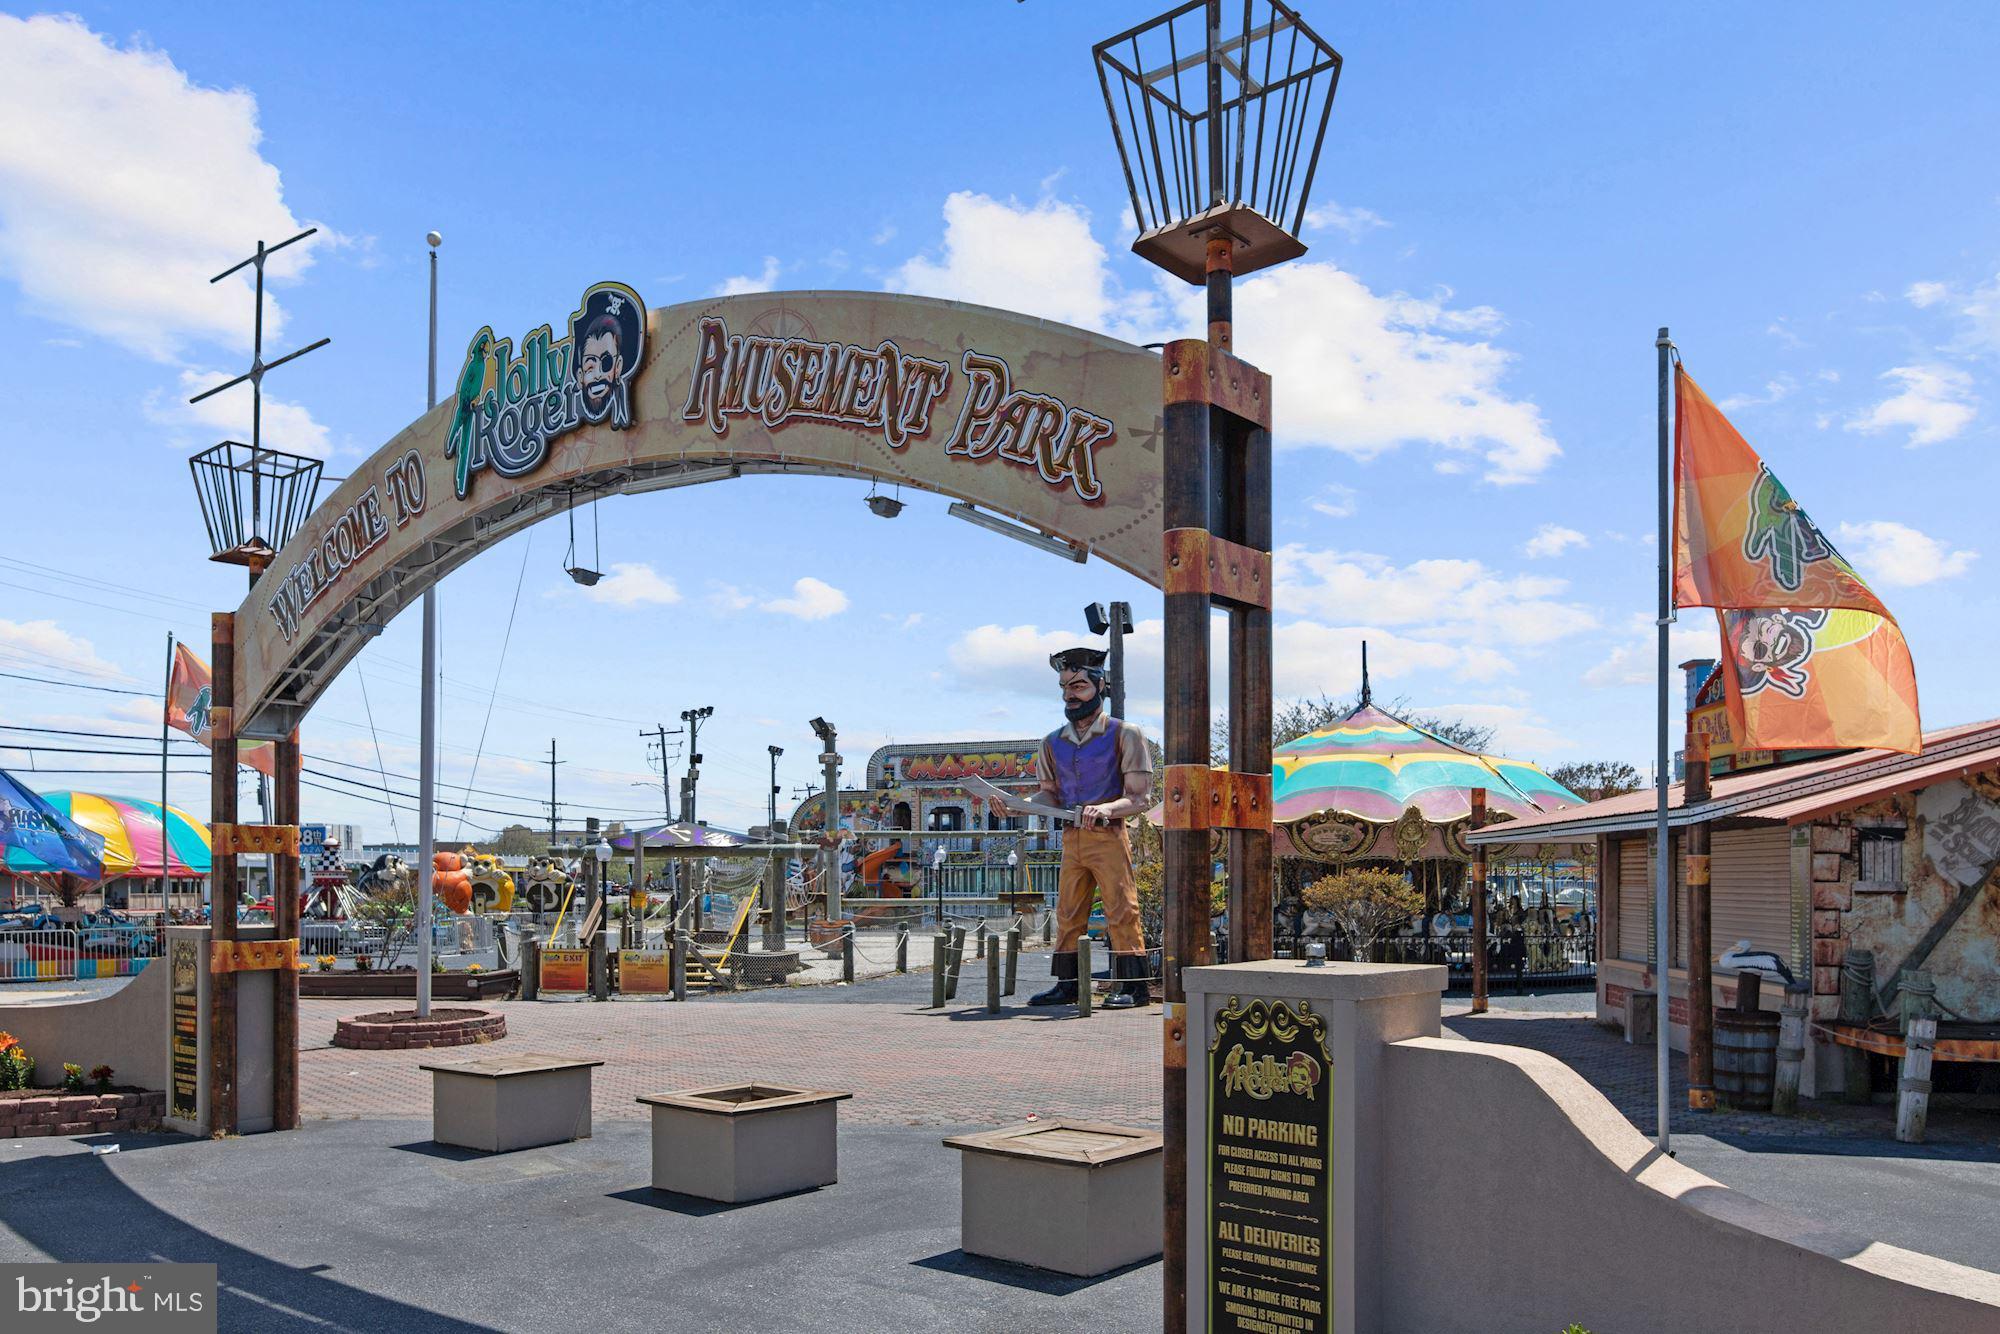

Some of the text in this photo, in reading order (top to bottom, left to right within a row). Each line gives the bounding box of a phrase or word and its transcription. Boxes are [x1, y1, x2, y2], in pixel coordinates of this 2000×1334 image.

[484, 331, 571, 415] Jolly
[682, 316, 1114, 501] AMUSEMENT PARK
[472, 383, 580, 474] Roger
[268, 448, 426, 641] WELCOME TO
[907, 752, 1017, 779] MARDI
[299, 829, 322, 846] 8th
[563, 954, 583, 962] EXIT
[1240, 1051, 1288, 1078] Jolly
[1233, 1067, 1290, 1100] Roger
[1222, 1114, 1318, 1147] NO PARKING
[1218, 1144, 1230, 1156] FOR
[1230, 1146, 1253, 1159] CLOSER
[1254, 1149, 1278, 1163] ACCESS
[1279, 1153, 1288, 1165] TO
[1288, 1154, 1299, 1167] ALL
[1223, 1162, 1315, 1187] PLEASE FOLLOW SIGNS TO OUR
[1228, 1180, 1310, 1204] PREFERRED PARKING AREA
[1218, 1220, 1321, 1257] ALL DELIVERIES
[1222, 1247, 1318, 1275] PLEASE USE PARK BACK ENTRANCE
[1218, 1280, 1321, 1315] WE ARE A SMOKE FREE PARK
[1225, 1301, 1314, 1332] SMOKING IS PERMITTED IN
[1237, 1316, 1278, 1334] DESIGNATED
